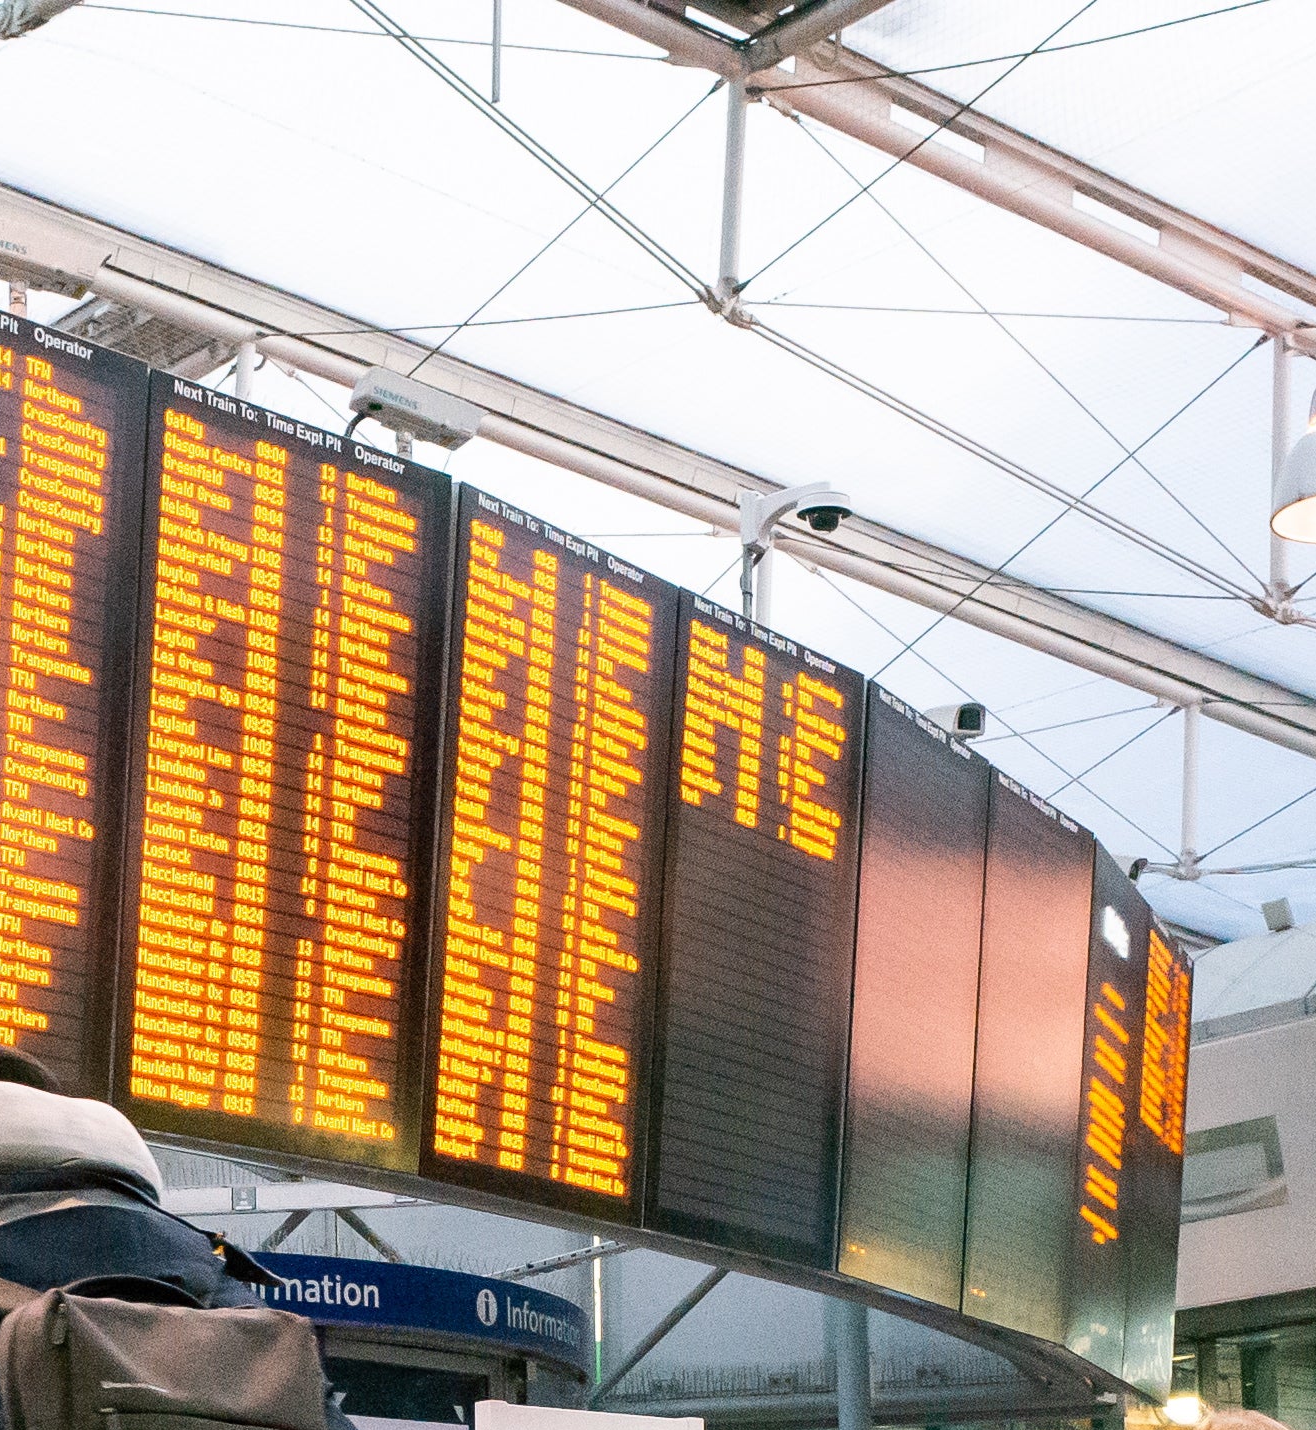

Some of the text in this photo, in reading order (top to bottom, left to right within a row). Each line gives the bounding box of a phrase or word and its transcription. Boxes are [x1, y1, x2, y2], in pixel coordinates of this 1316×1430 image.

[0, 314, 18, 334] Plt
[34, 327, 93, 360] Operator
[24, 355, 54, 379] TFW
[22, 377, 82, 412] Northern
[373, 386, 418, 410] SIEMENS
[19, 421, 106, 468] CrossCountry
[21, 399, 107, 447] CrossCountry
[173, 379, 405, 474] Next Train To: Time Expt Plt Operator
[17, 465, 103, 512] CrossCountry
[20, 443, 102, 488] Transpennine
[15, 510, 75, 544] Northern
[16, 488, 102, 534] CrossCountry
[14, 532, 74, 566] Northern
[478, 493, 644, 583] Next Train To: Time Expt Plt Operator
[507, 1296, 580, 1347] Information
